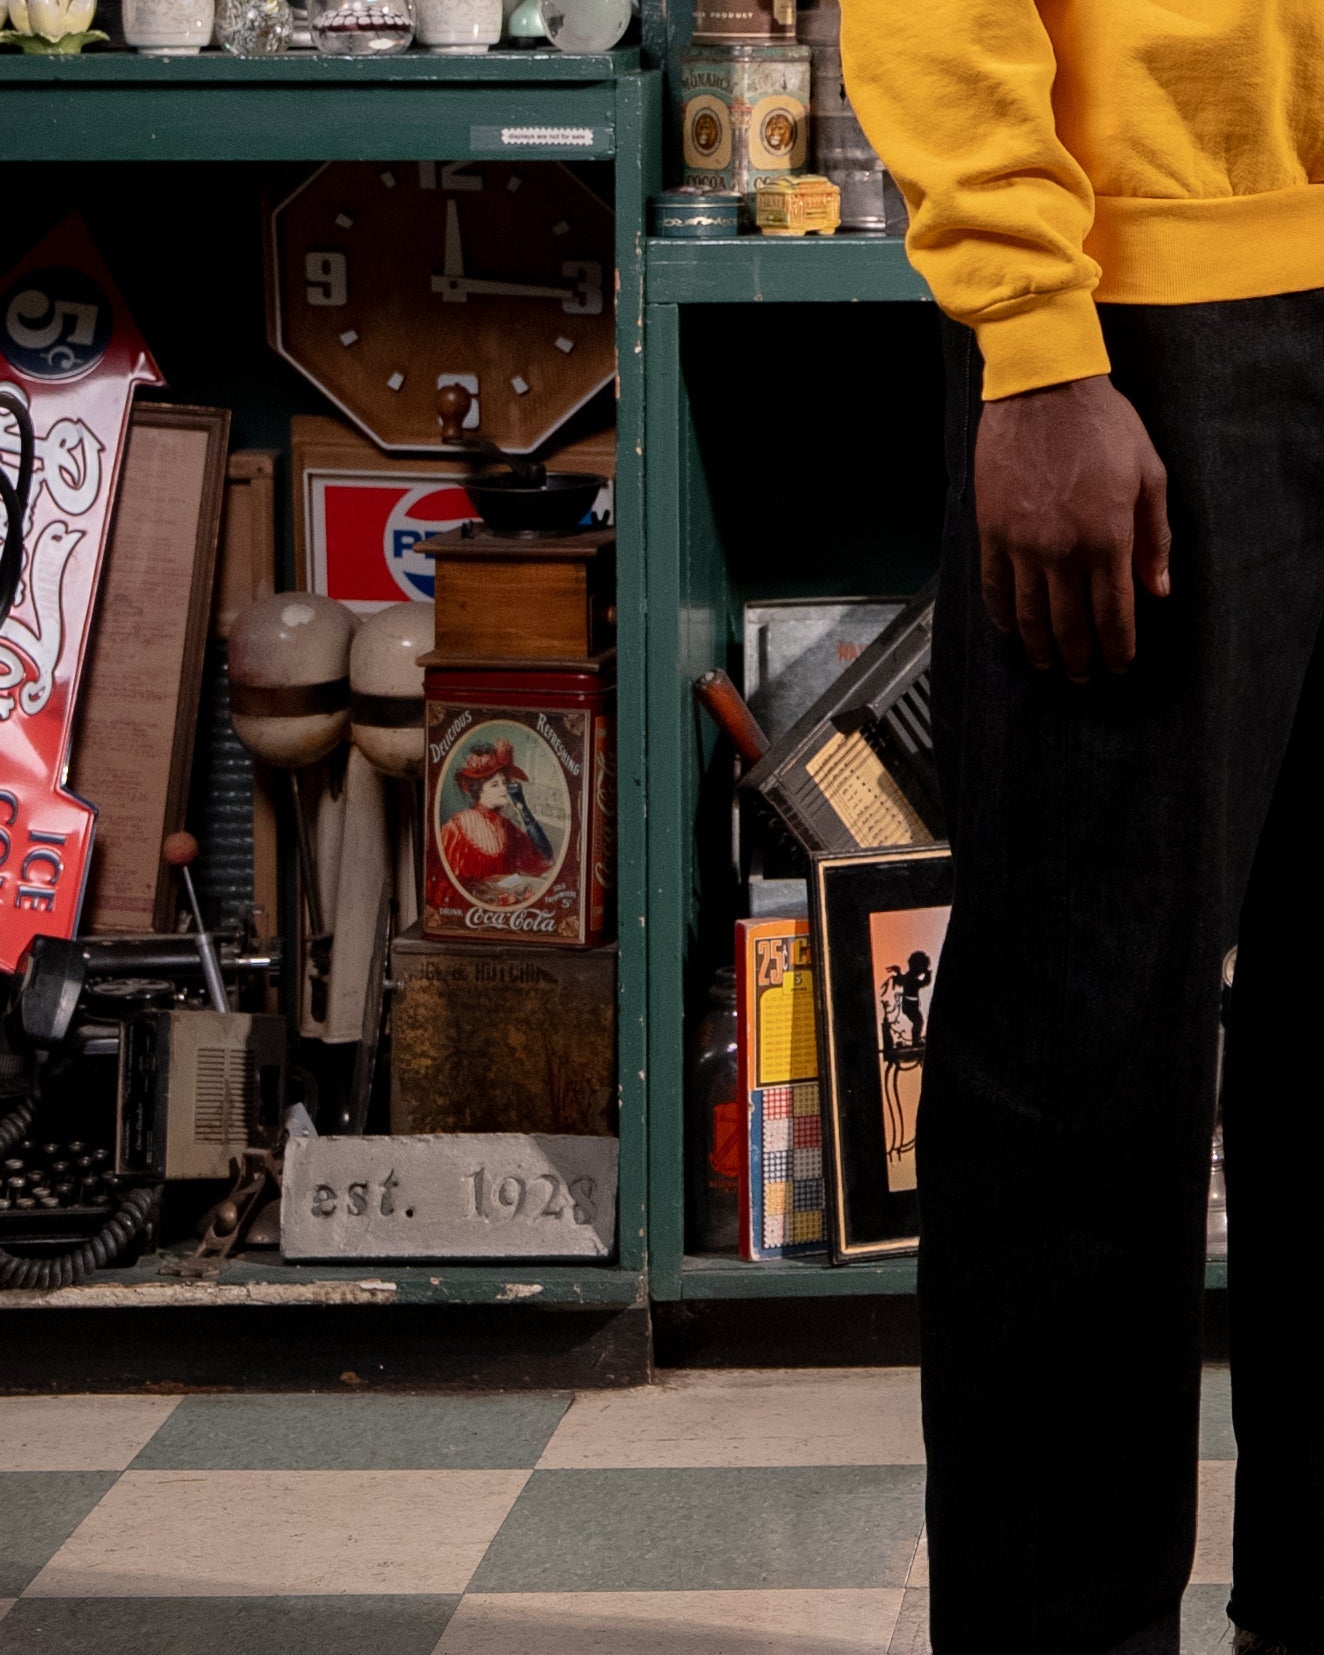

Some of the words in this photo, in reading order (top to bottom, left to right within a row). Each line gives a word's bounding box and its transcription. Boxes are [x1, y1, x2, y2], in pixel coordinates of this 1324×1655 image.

[711, 10, 754, 20] PRODUCT
[305, 251, 348, 307] 9
[561, 260, 604, 315] 3
[430, 710, 473, 764] DELICIOUS
[536, 712, 581, 777] REFRESHING
[15, 829, 67, 912] ICE
[464, 906, 558, 933] Coca-Cola
[311, 1167, 416, 1219] est.
[463, 1166, 598, 1226] 1928
